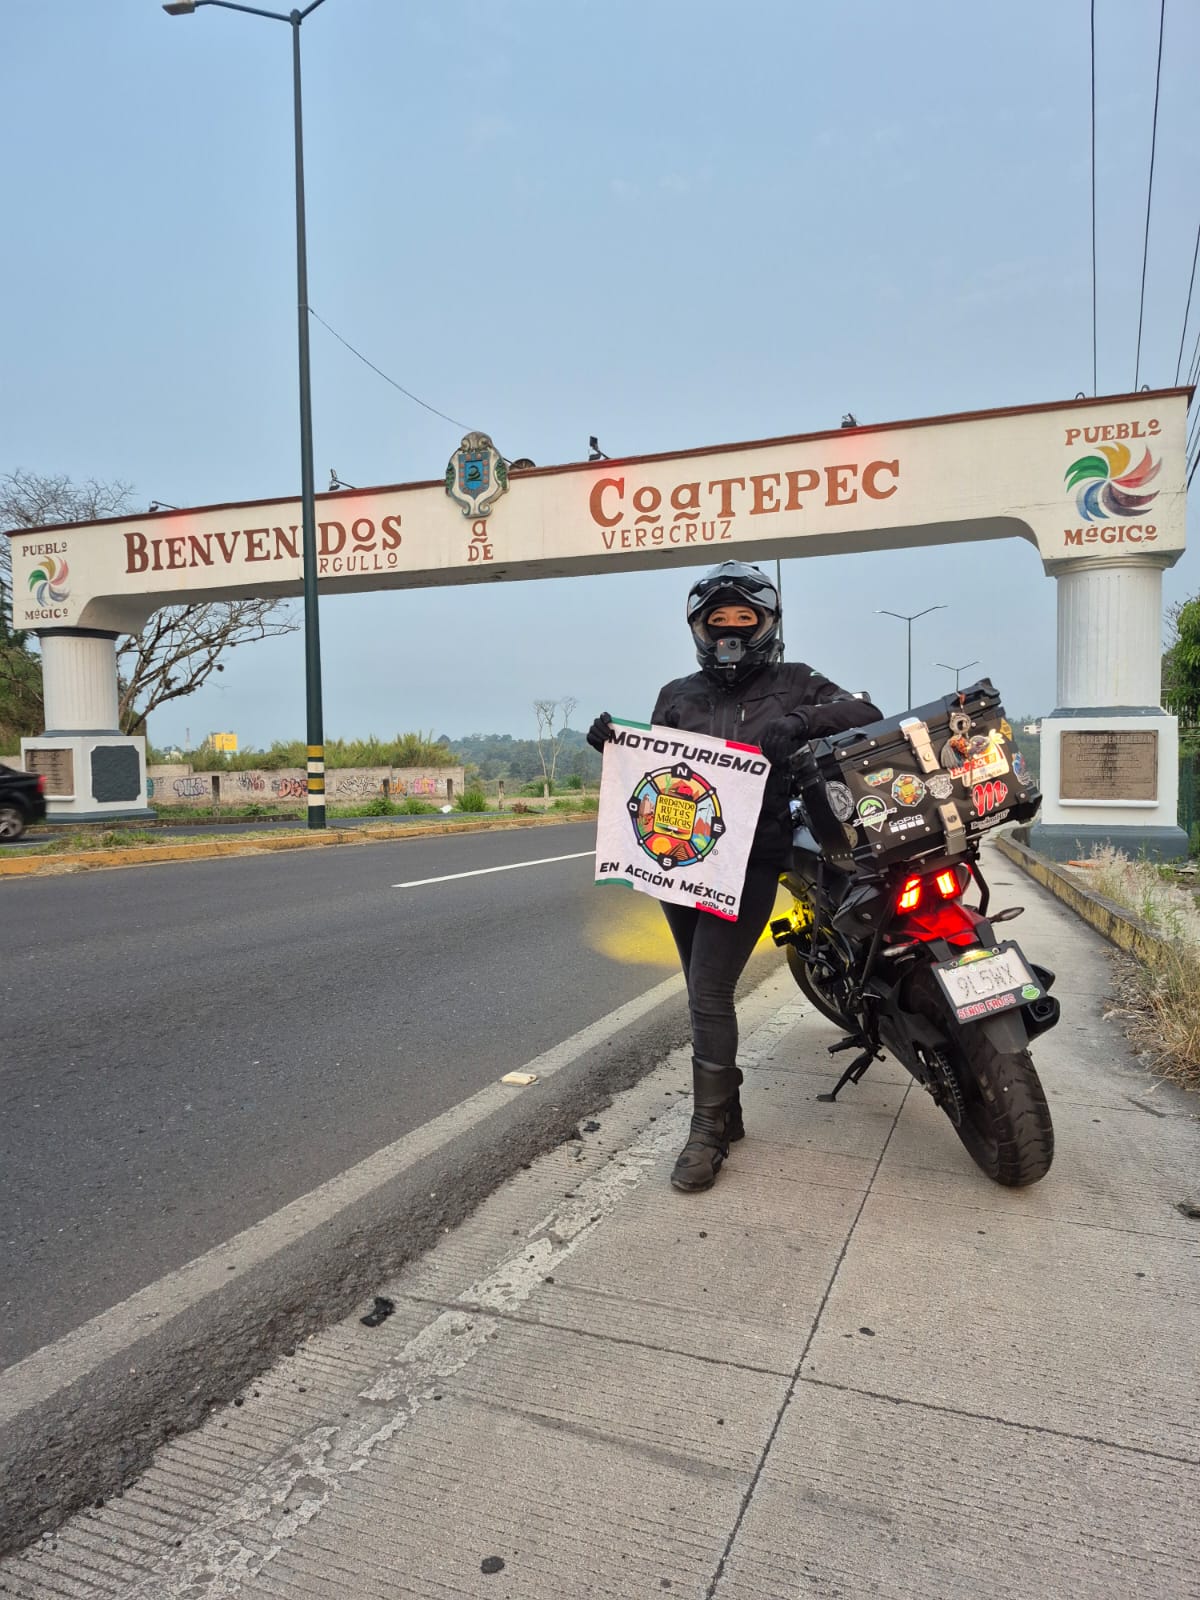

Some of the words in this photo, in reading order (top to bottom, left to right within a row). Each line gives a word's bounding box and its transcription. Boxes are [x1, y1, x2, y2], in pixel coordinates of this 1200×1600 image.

[124, 514, 402, 574] BIENVENDOS
[467, 543, 494, 562] DE
[676, 767, 688, 776] N
[629, 803, 638, 811] O
[889, 814, 923, 828] GoPro
[713, 823, 722, 832] E
[663, 857, 672, 866] S
[599, 861, 620, 873] EN
[625, 864, 675, 889] ACCIÓN
[680, 880, 736, 907] MÉXICO
